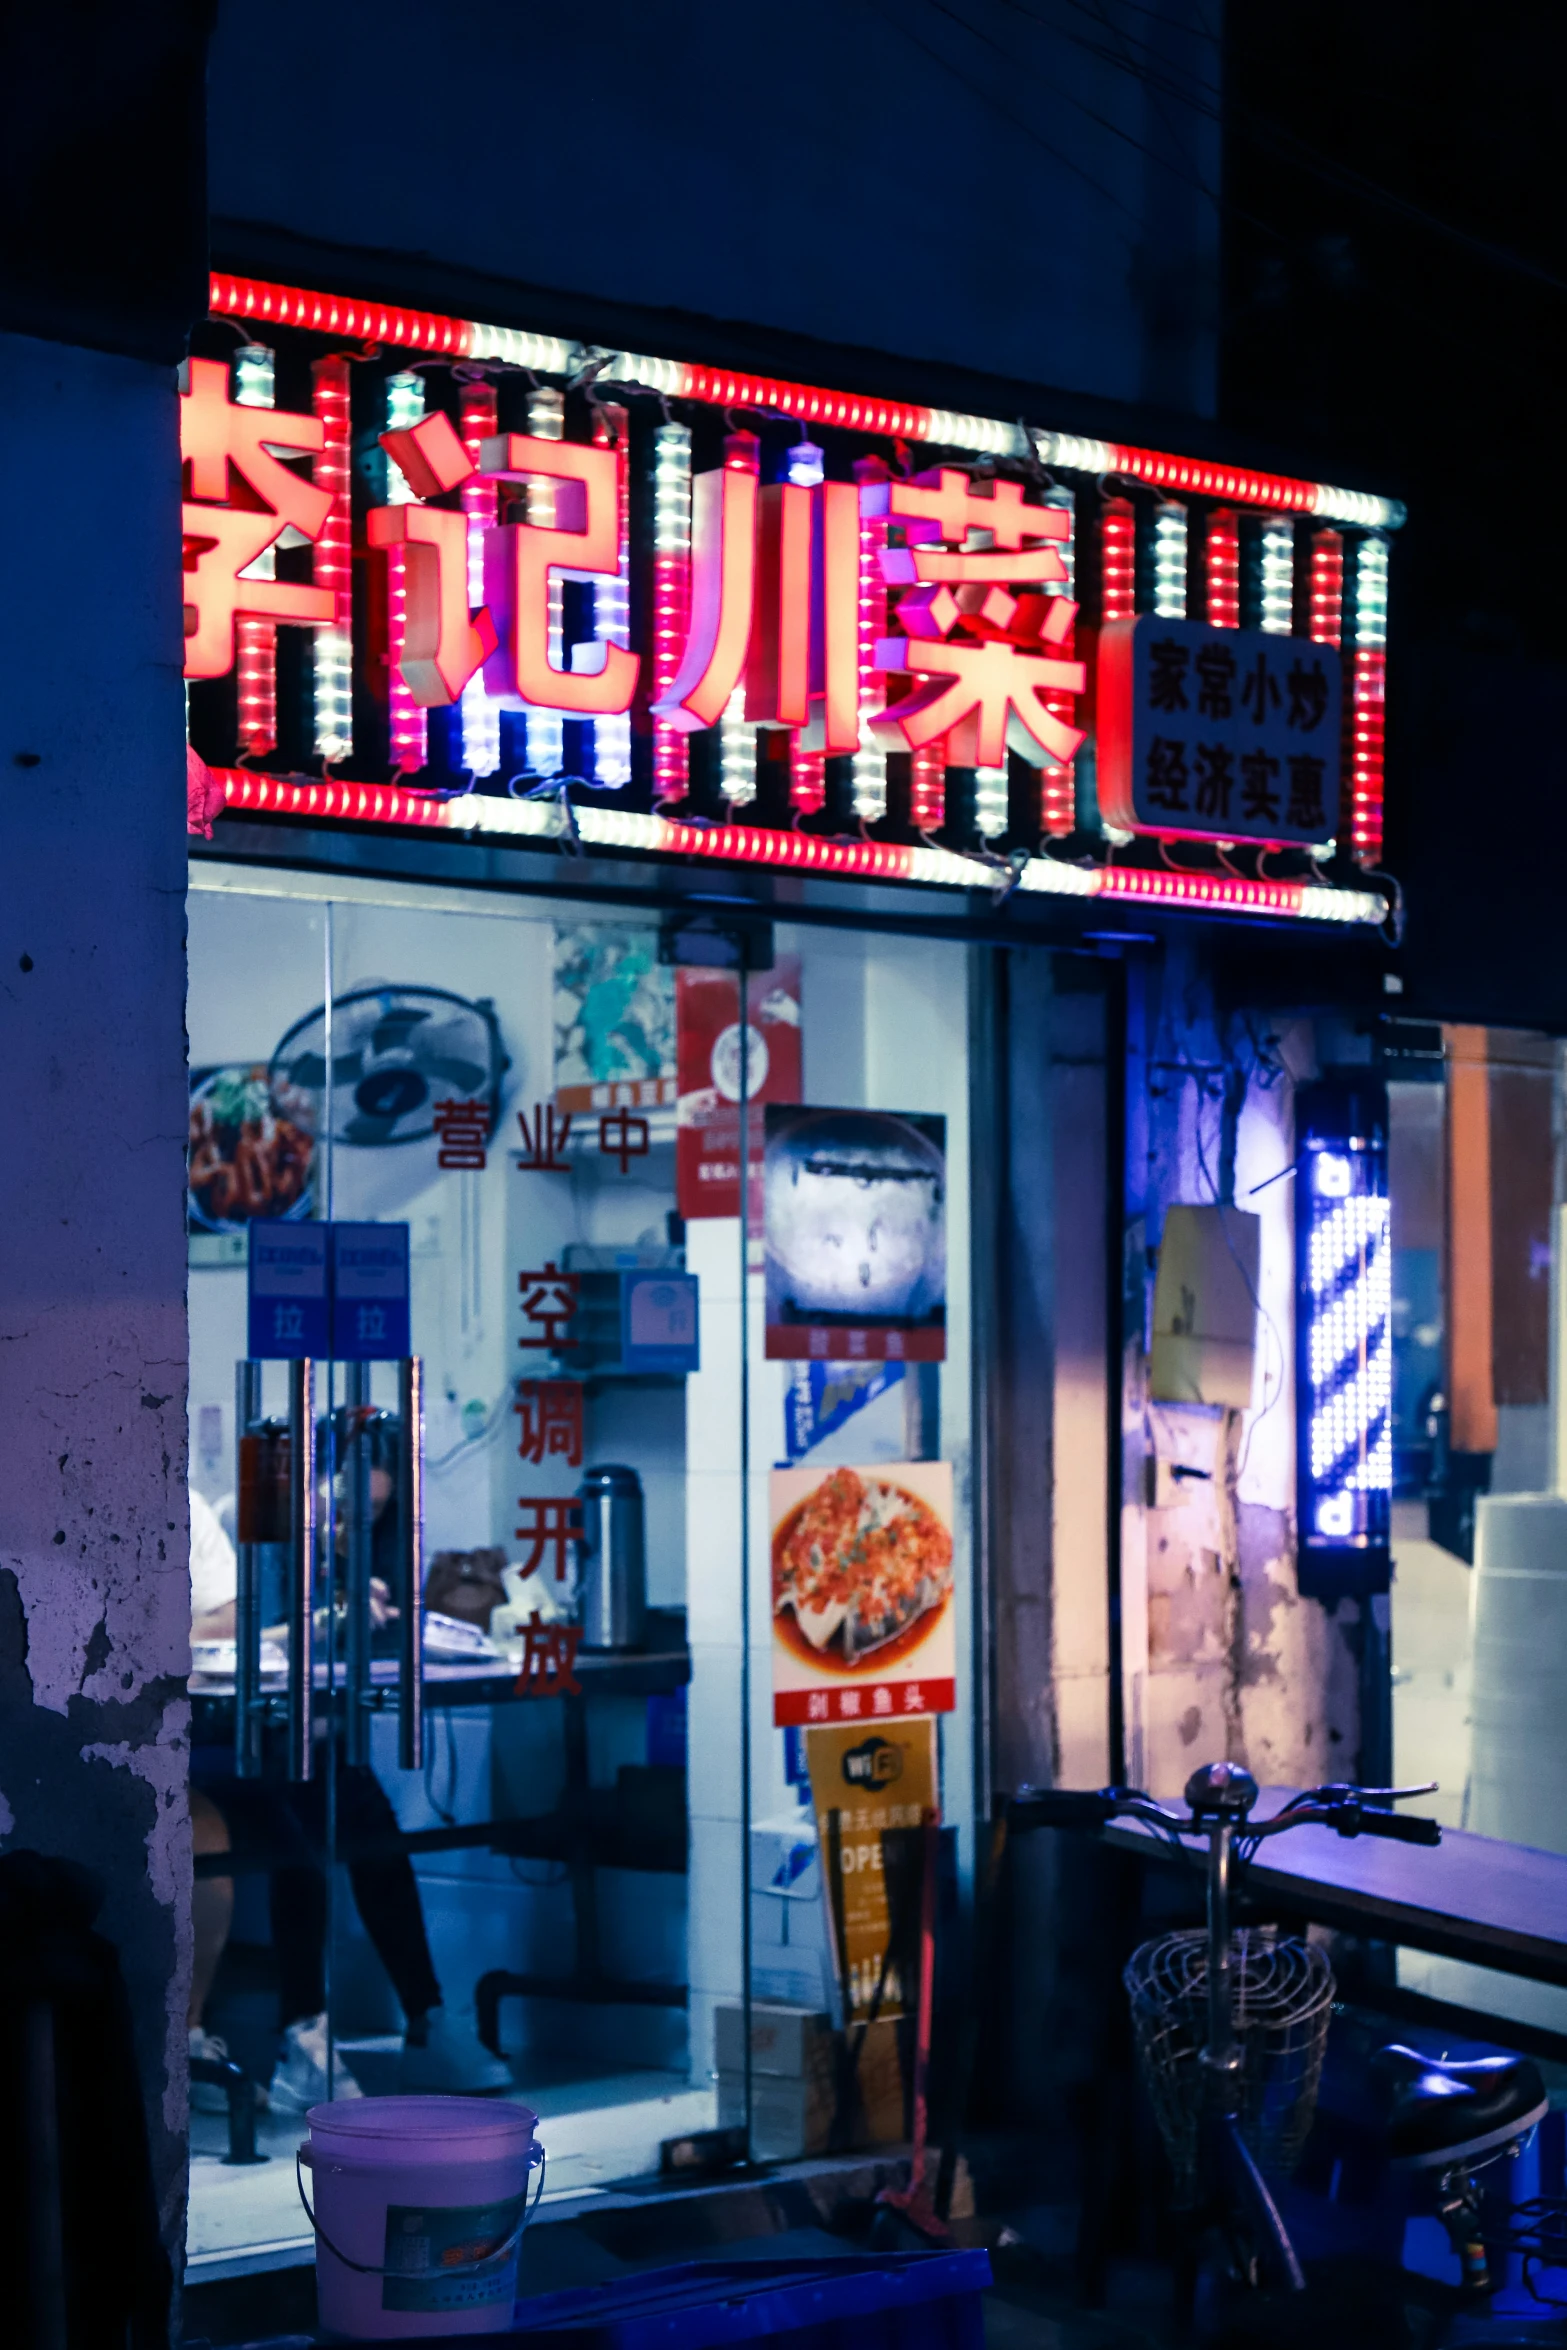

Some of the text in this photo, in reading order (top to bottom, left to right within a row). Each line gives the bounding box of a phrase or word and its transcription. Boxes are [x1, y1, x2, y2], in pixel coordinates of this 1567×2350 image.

[180, 357, 1087, 767] 李记川菜
[1148, 636, 1330, 733] 家常小炒
[1146, 734, 1327, 830] 经济实惠
[432, 1097, 650, 1175] 营业中
[272, 1302, 305, 1341] 拉
[356, 1304, 388, 1342] 拉
[513, 1262, 585, 1697] 空调开放
